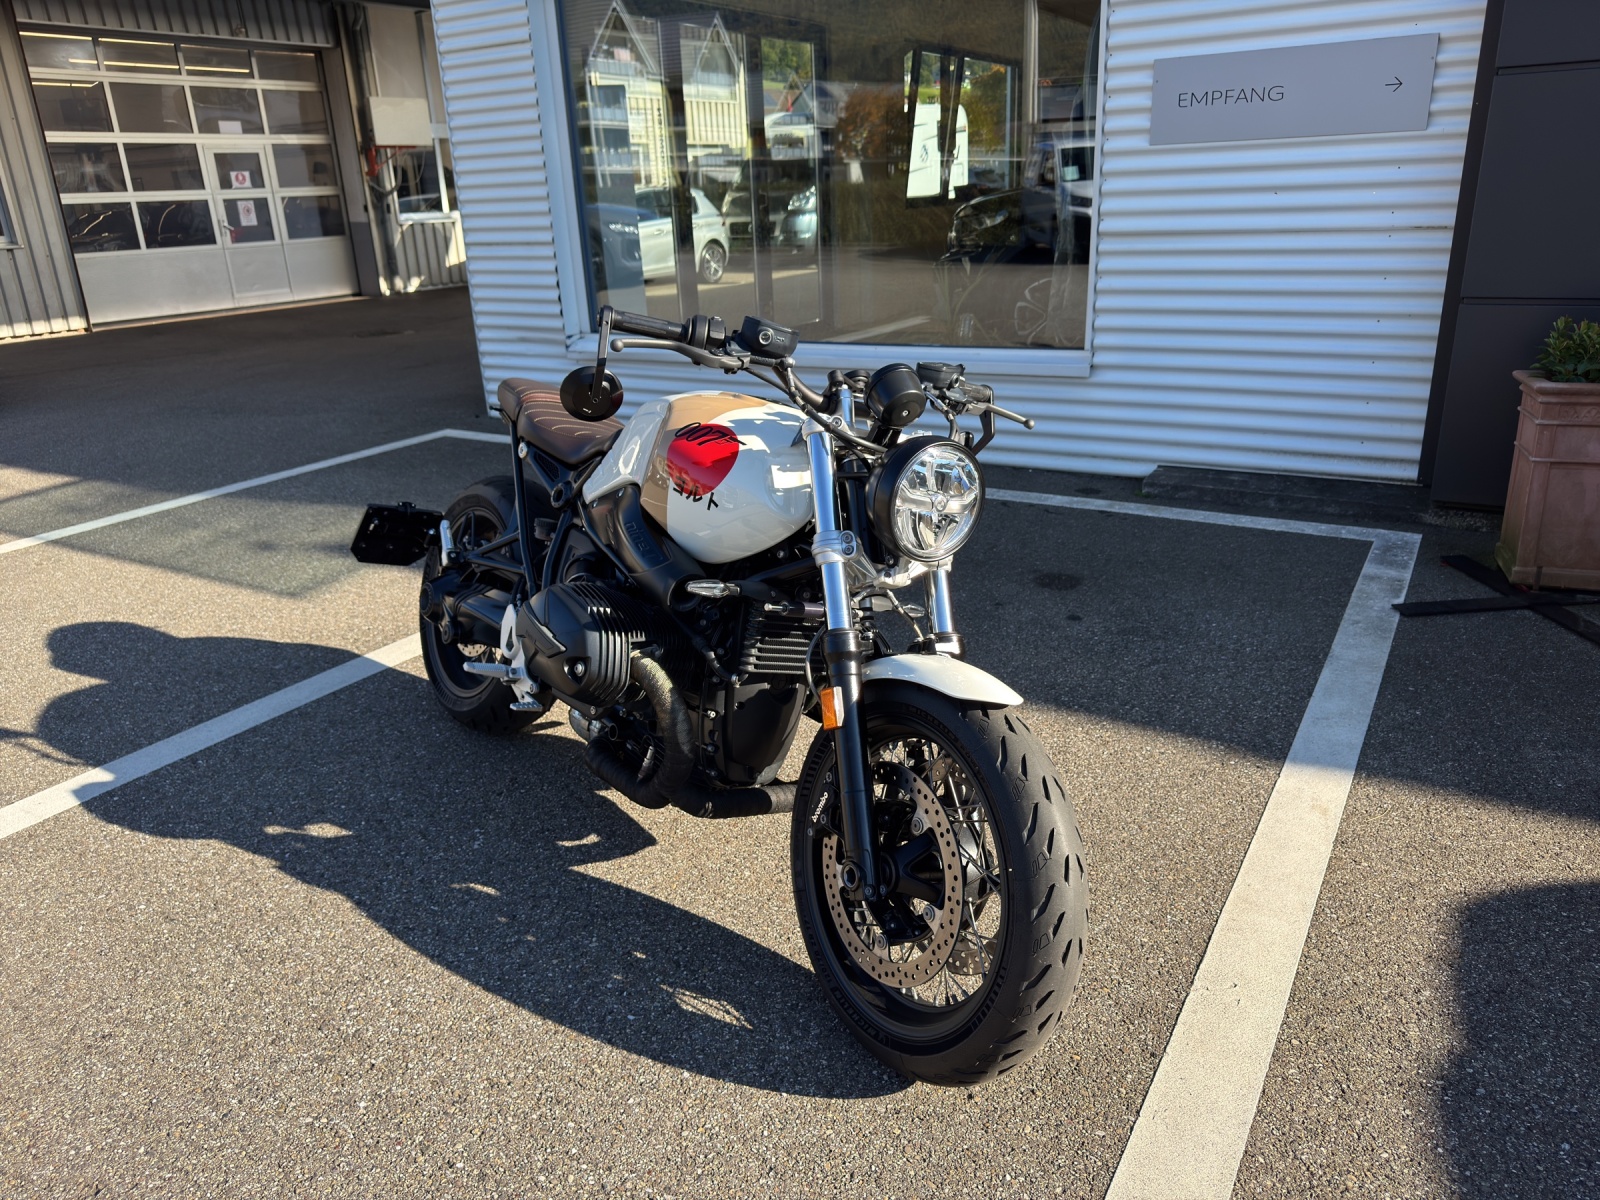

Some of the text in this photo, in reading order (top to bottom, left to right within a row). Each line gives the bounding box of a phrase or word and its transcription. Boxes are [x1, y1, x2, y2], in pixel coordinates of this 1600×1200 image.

[1178, 85, 1285, 108] EMPFANG
[675, 422, 746, 446] 007
[811, 791, 829, 823] brembo
[833, 989, 876, 1036] MICHELIN
